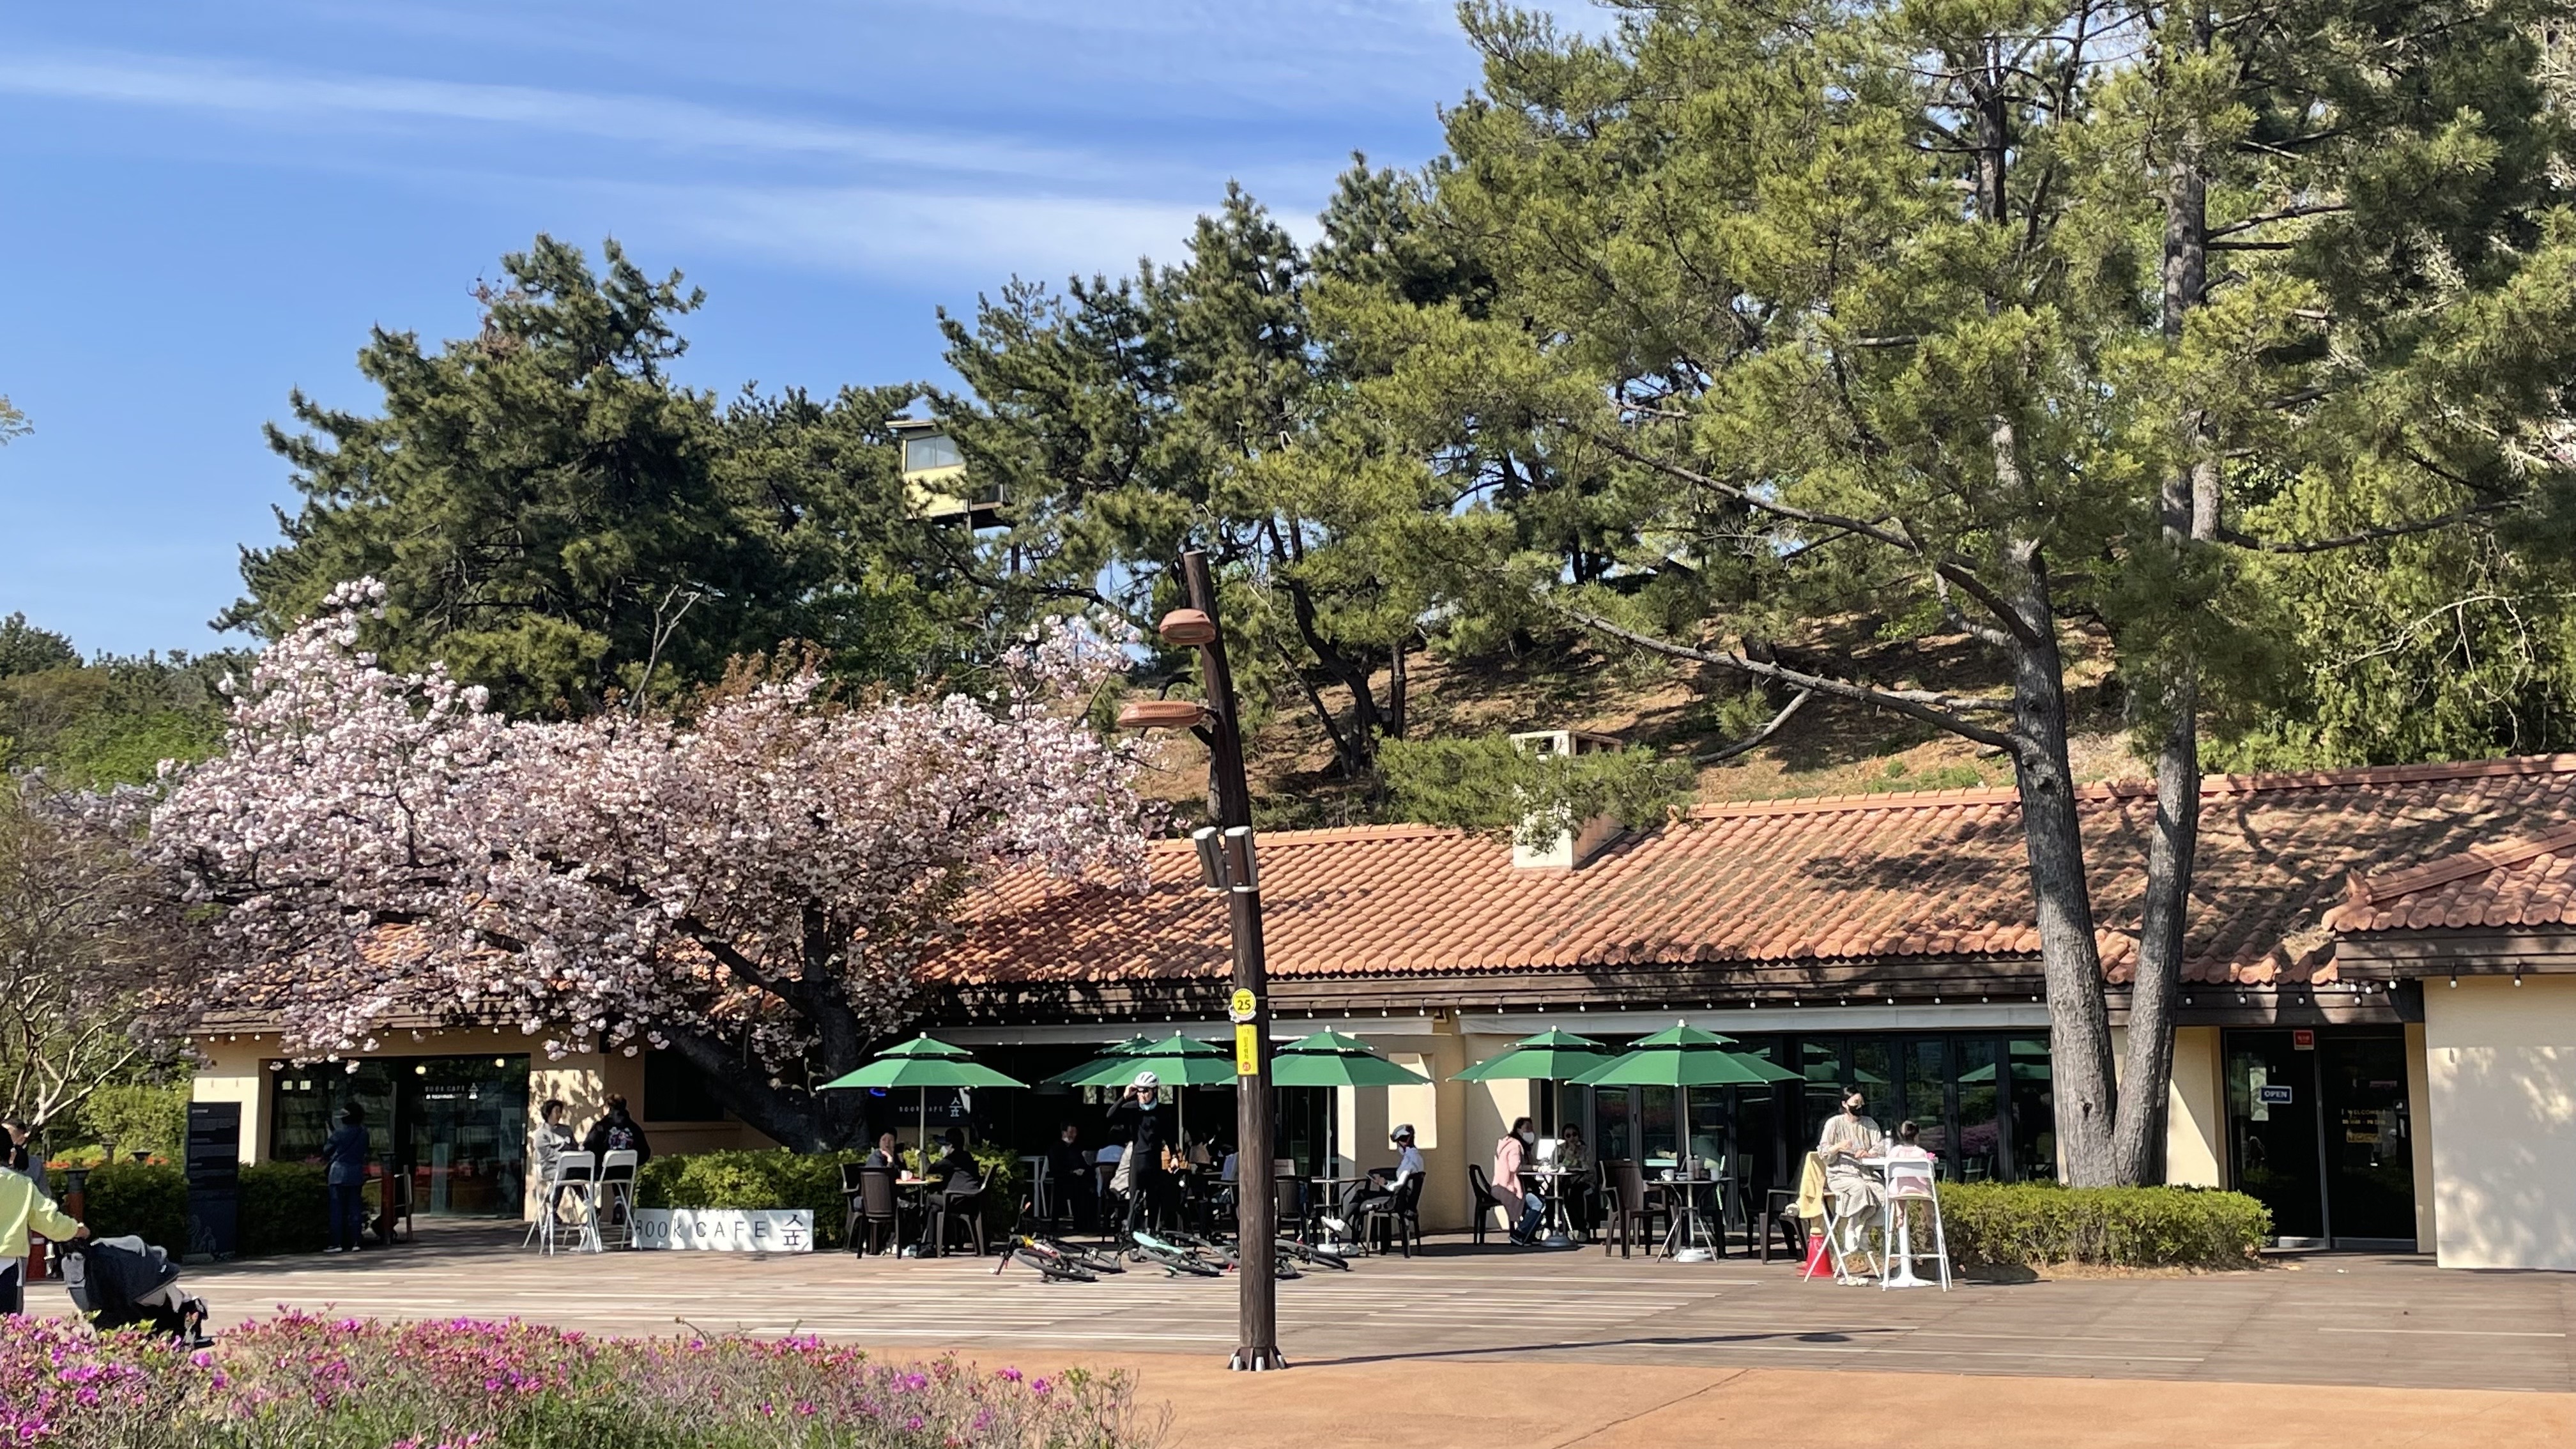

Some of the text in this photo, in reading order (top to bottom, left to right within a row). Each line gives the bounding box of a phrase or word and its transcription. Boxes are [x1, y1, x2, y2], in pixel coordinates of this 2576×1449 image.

[1237, 1000, 1251, 1010] 25
[949, 1097, 963, 1117] 숲
[696, 1221, 766, 1241] CAFE
[780, 1214, 808, 1246] 숲
